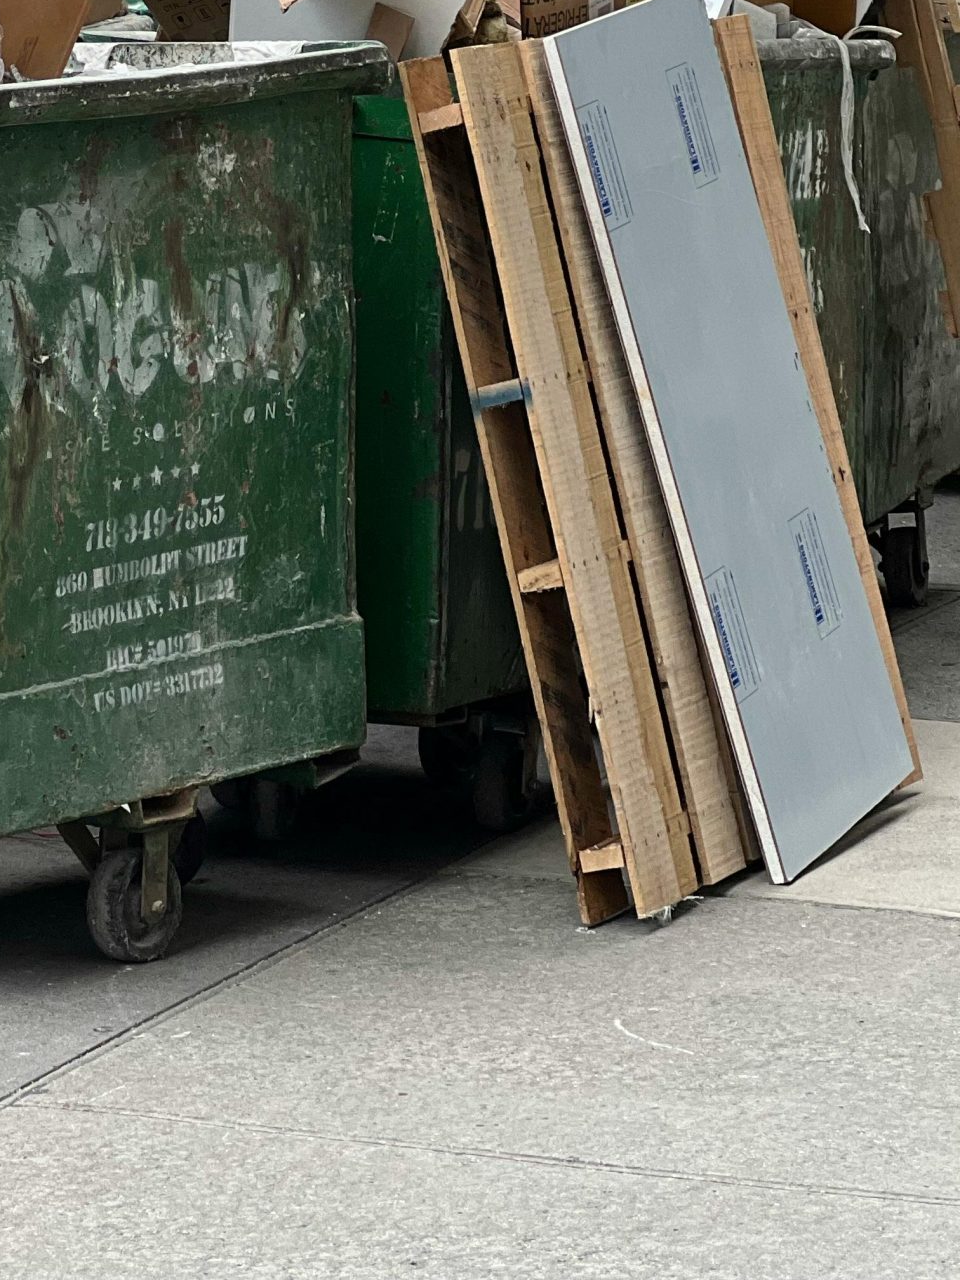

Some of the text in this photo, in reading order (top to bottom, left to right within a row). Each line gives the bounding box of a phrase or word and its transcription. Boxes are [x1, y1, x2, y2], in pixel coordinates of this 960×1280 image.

[55, 570, 88, 598] 860
[186, 535, 249, 568] STREET
[168, 589, 189, 611] NY
